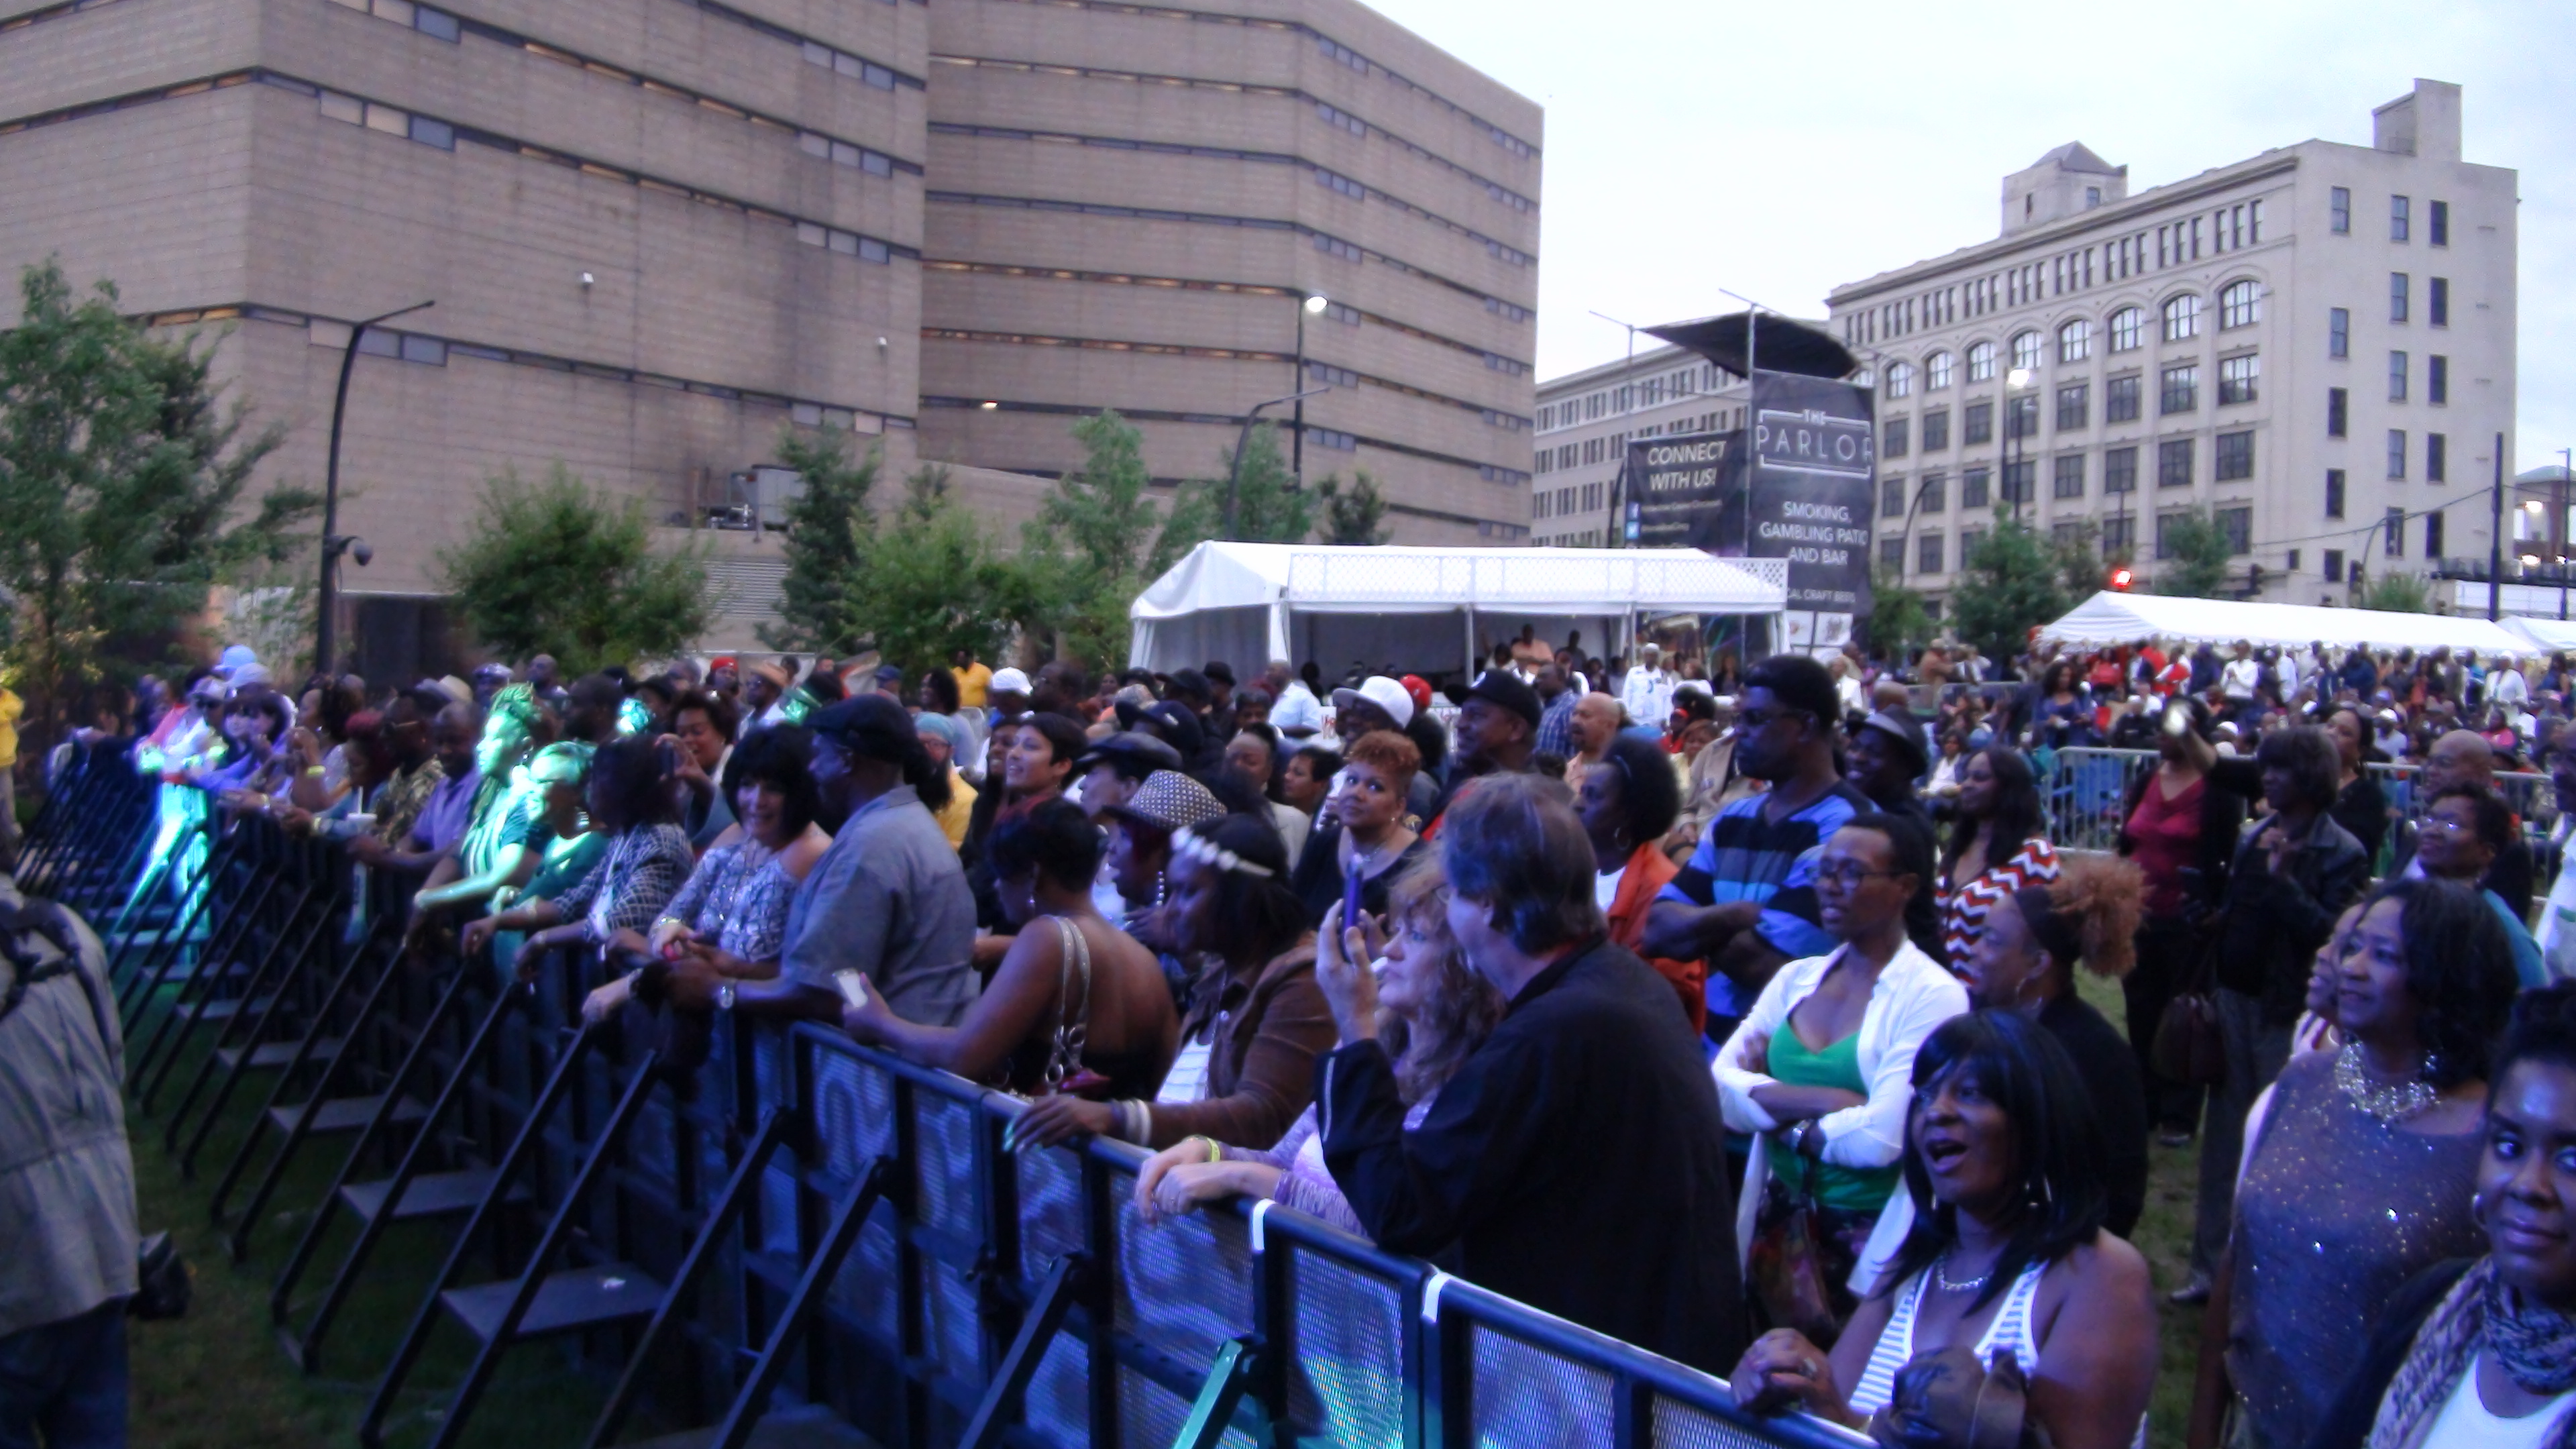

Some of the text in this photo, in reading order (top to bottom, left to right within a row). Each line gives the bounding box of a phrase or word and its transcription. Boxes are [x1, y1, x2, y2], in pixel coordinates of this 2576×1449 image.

[1803, 409, 1827, 426] THE
[1648, 440, 1727, 466] CONNECT
[1755, 424, 1874, 464] PARLOR
[1650, 468, 1718, 491] WITH US!
[1759, 521, 1834, 544] GAMBLING
[1788, 546, 1849, 566] AND BAR
